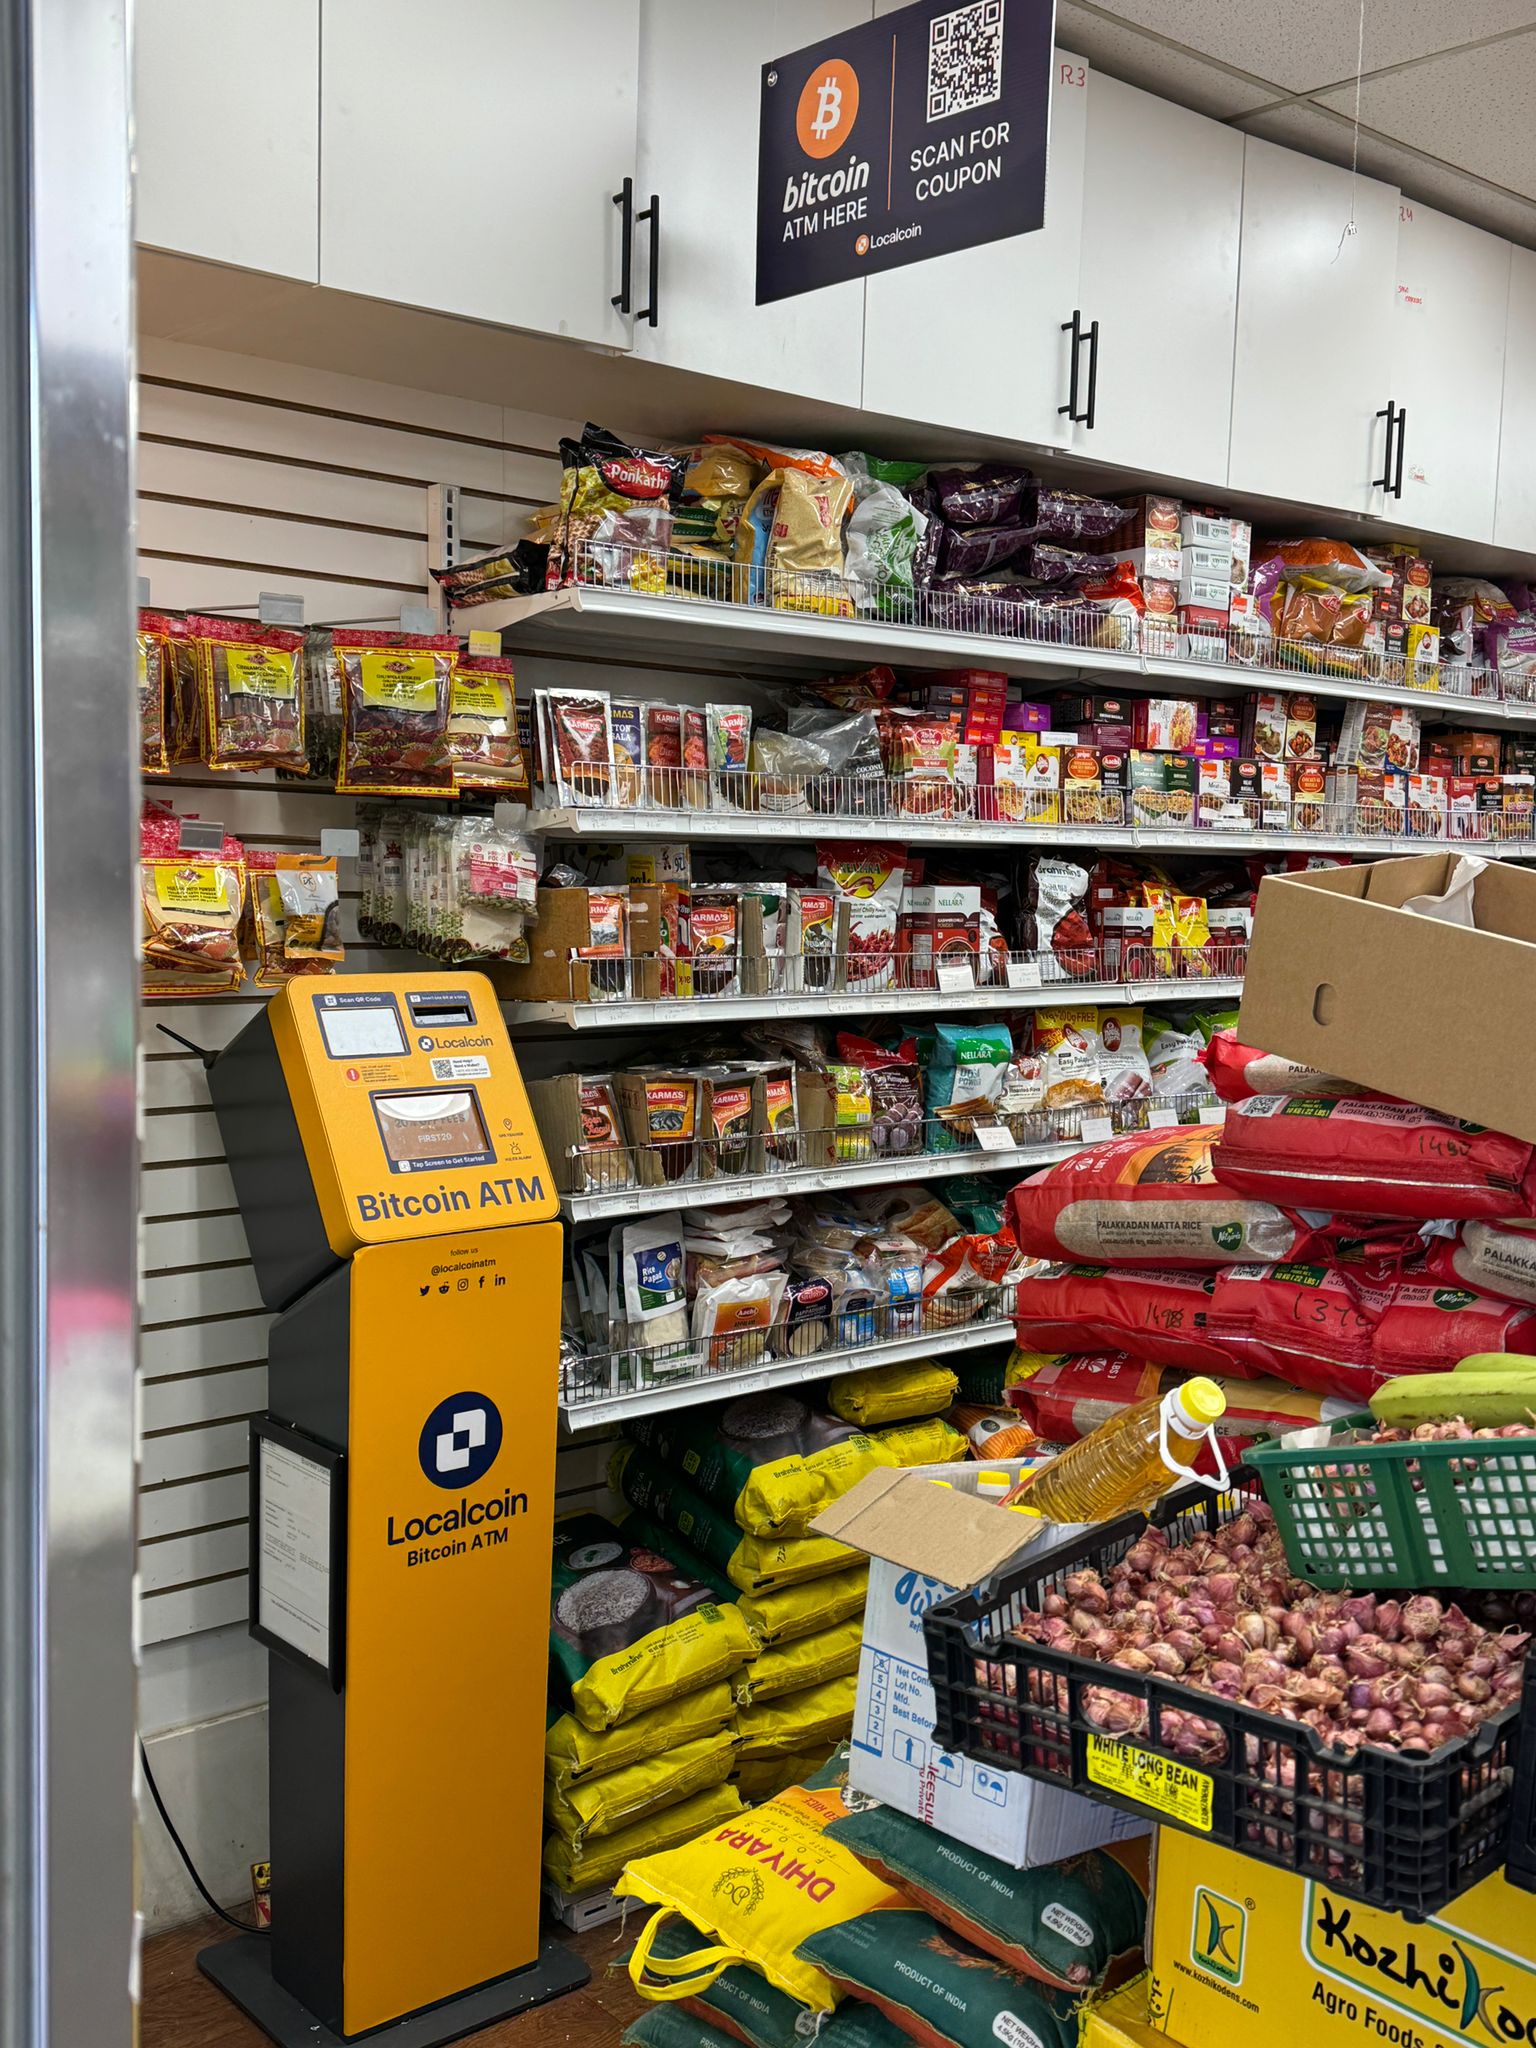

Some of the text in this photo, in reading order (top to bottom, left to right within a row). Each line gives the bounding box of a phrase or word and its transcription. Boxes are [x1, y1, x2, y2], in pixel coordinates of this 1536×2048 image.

[1061, 65, 1086, 87] R3
[910, 122, 1010, 172] SCAN FOR
[782, 156, 869, 213] bitcoin
[916, 157, 1001, 201] COUPON
[783, 197, 867, 242] ATM HERE
[870, 223, 922, 249] Localcoin
[802, 901, 825, 909] RMA'S
[1077, 1012, 1095, 1022] FREE
[435, 1036, 493, 1048] Localcoin
[1161, 1041, 1175, 1050] Easy
[960, 1051, 991, 1060] NELLARA
[1059, 1058, 1074, 1066] Easy
[767, 1086, 786, 1097] RMA'S
[1342, 1101, 1406, 1114] PALAKKADAN
[418, 1133, 452, 1144] FIRST20
[413, 1161, 424, 1169] Tap
[464, 1155, 485, 1163] Started
[357, 1176, 545, 1221] Bitcoin ATM
[1097, 1221, 1201, 1230] PALAKKADAN MATTA RICE
[450, 1249, 469, 1257] follow
[431, 1258, 496, 1276] @localcoinatm
[642, 1266, 656, 1276] Rice
[643, 1271, 663, 1285] Papad
[1412, 1287, 1432, 1296] RICE
[1214, 1426, 1229, 1435] ICE
[387, 1488, 528, 1546] Localcoin
[407, 1527, 508, 1567] Bitcoin ATM
[896, 1664, 908, 1677] Net
[877, 1674, 883, 1684] 5
[895, 1678, 923, 1697] Lot No.
[875, 1690, 882, 1700] 4
[893, 1691, 910, 1706] Mfd.
[874, 1705, 880, 1715] 3
[892, 1705, 909, 1718] Best
[873, 1720, 879, 1731] 2
[873, 1736, 878, 1746] 1
[1093, 1734, 1129, 1762] WHITE
[1132, 1748, 1163, 1776] LONG
[1166, 1764, 1199, 1792] BEAN
[714, 1827, 836, 1903] DHIYARA
[936, 1844, 1014, 1899] PRODUCT OF INDIA
[1050, 1907, 1091, 1938] NET WEIGHT
[1063, 1924, 1075, 1936] (10
[894, 1960, 967, 2013] PRODUCT OF INDIA
[1173, 1960, 1260, 2014] www.kozhikodens.com
[738, 1990, 770, 2015] OF INDIA
[1001, 2015, 1014, 2027] NET
[1312, 1981, 1423, 2048] Agro Foods
